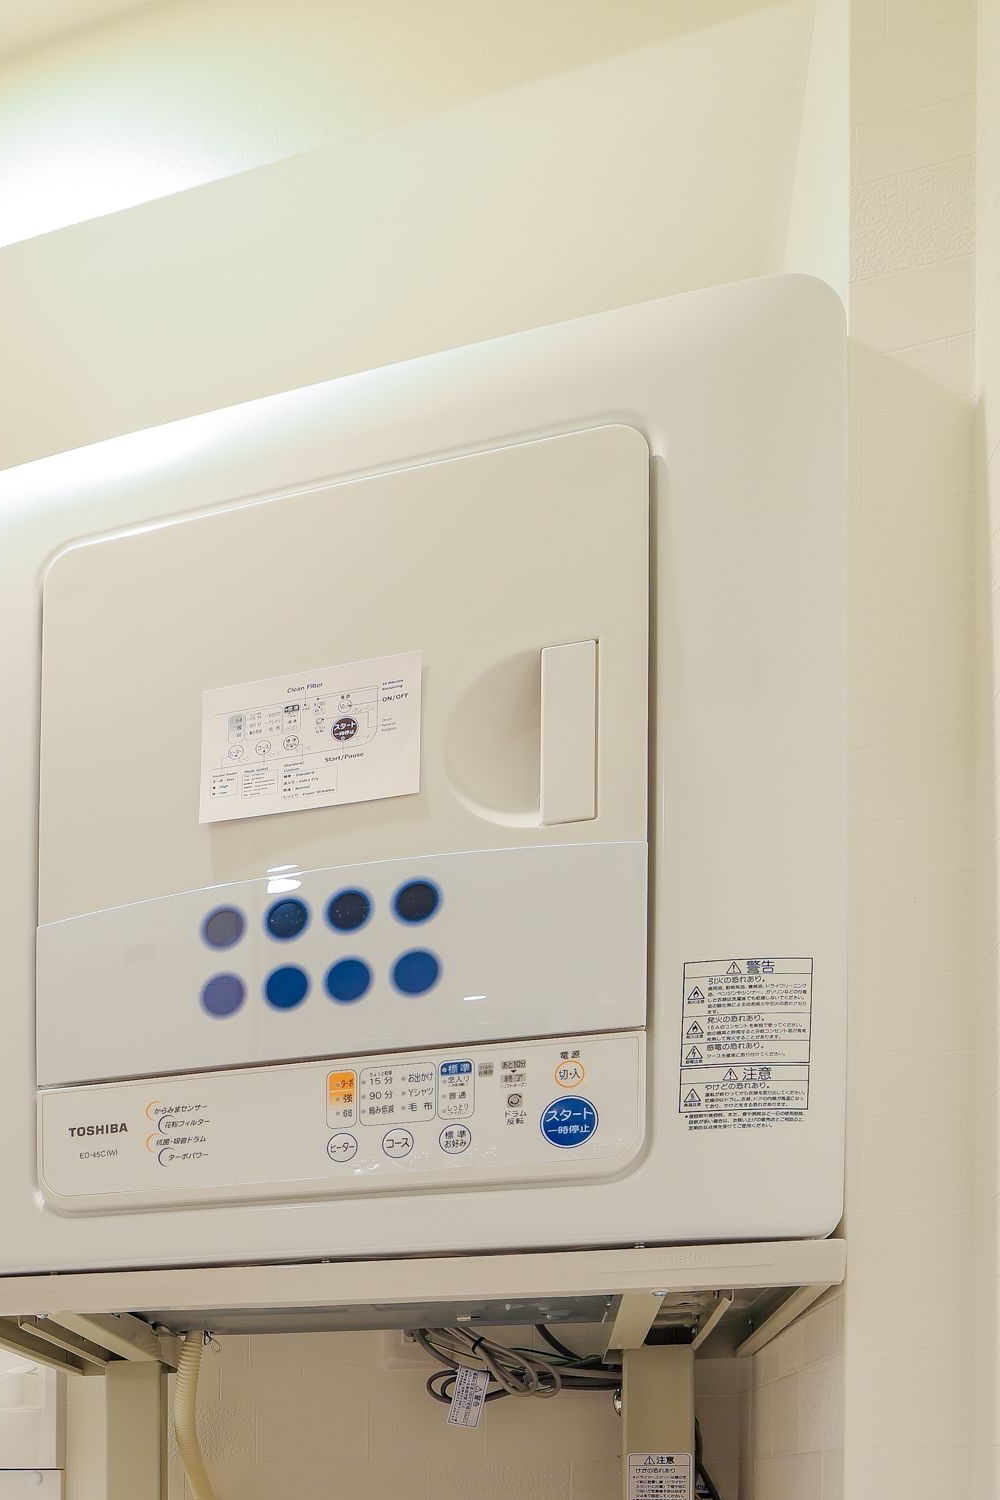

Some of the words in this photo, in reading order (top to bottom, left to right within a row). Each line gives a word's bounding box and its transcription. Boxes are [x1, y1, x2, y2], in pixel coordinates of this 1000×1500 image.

[287, 686, 305, 694] Clean
[306, 682, 323, 690] Filter
[382, 693, 409, 702] ON/OFF
[325, 751, 364, 763] Start/Pause
[746, 960, 775, 974] 警告
[408, 1073, 433, 1083] お出かけ
[742, 1066, 772, 1080] 注意
[369, 1091, 382, 1100] 90
[504, 1110, 527, 1118] ドラム
[547, 1107, 593, 1122] スタート
[69, 1122, 128, 1137] TOSHIBA
[547, 1124, 590, 1135] 一時停止
[330, 1142, 355, 1154] ヒーター
[386, 1138, 410, 1148] コース
[169, 1152, 208, 1161] ターボパワー
